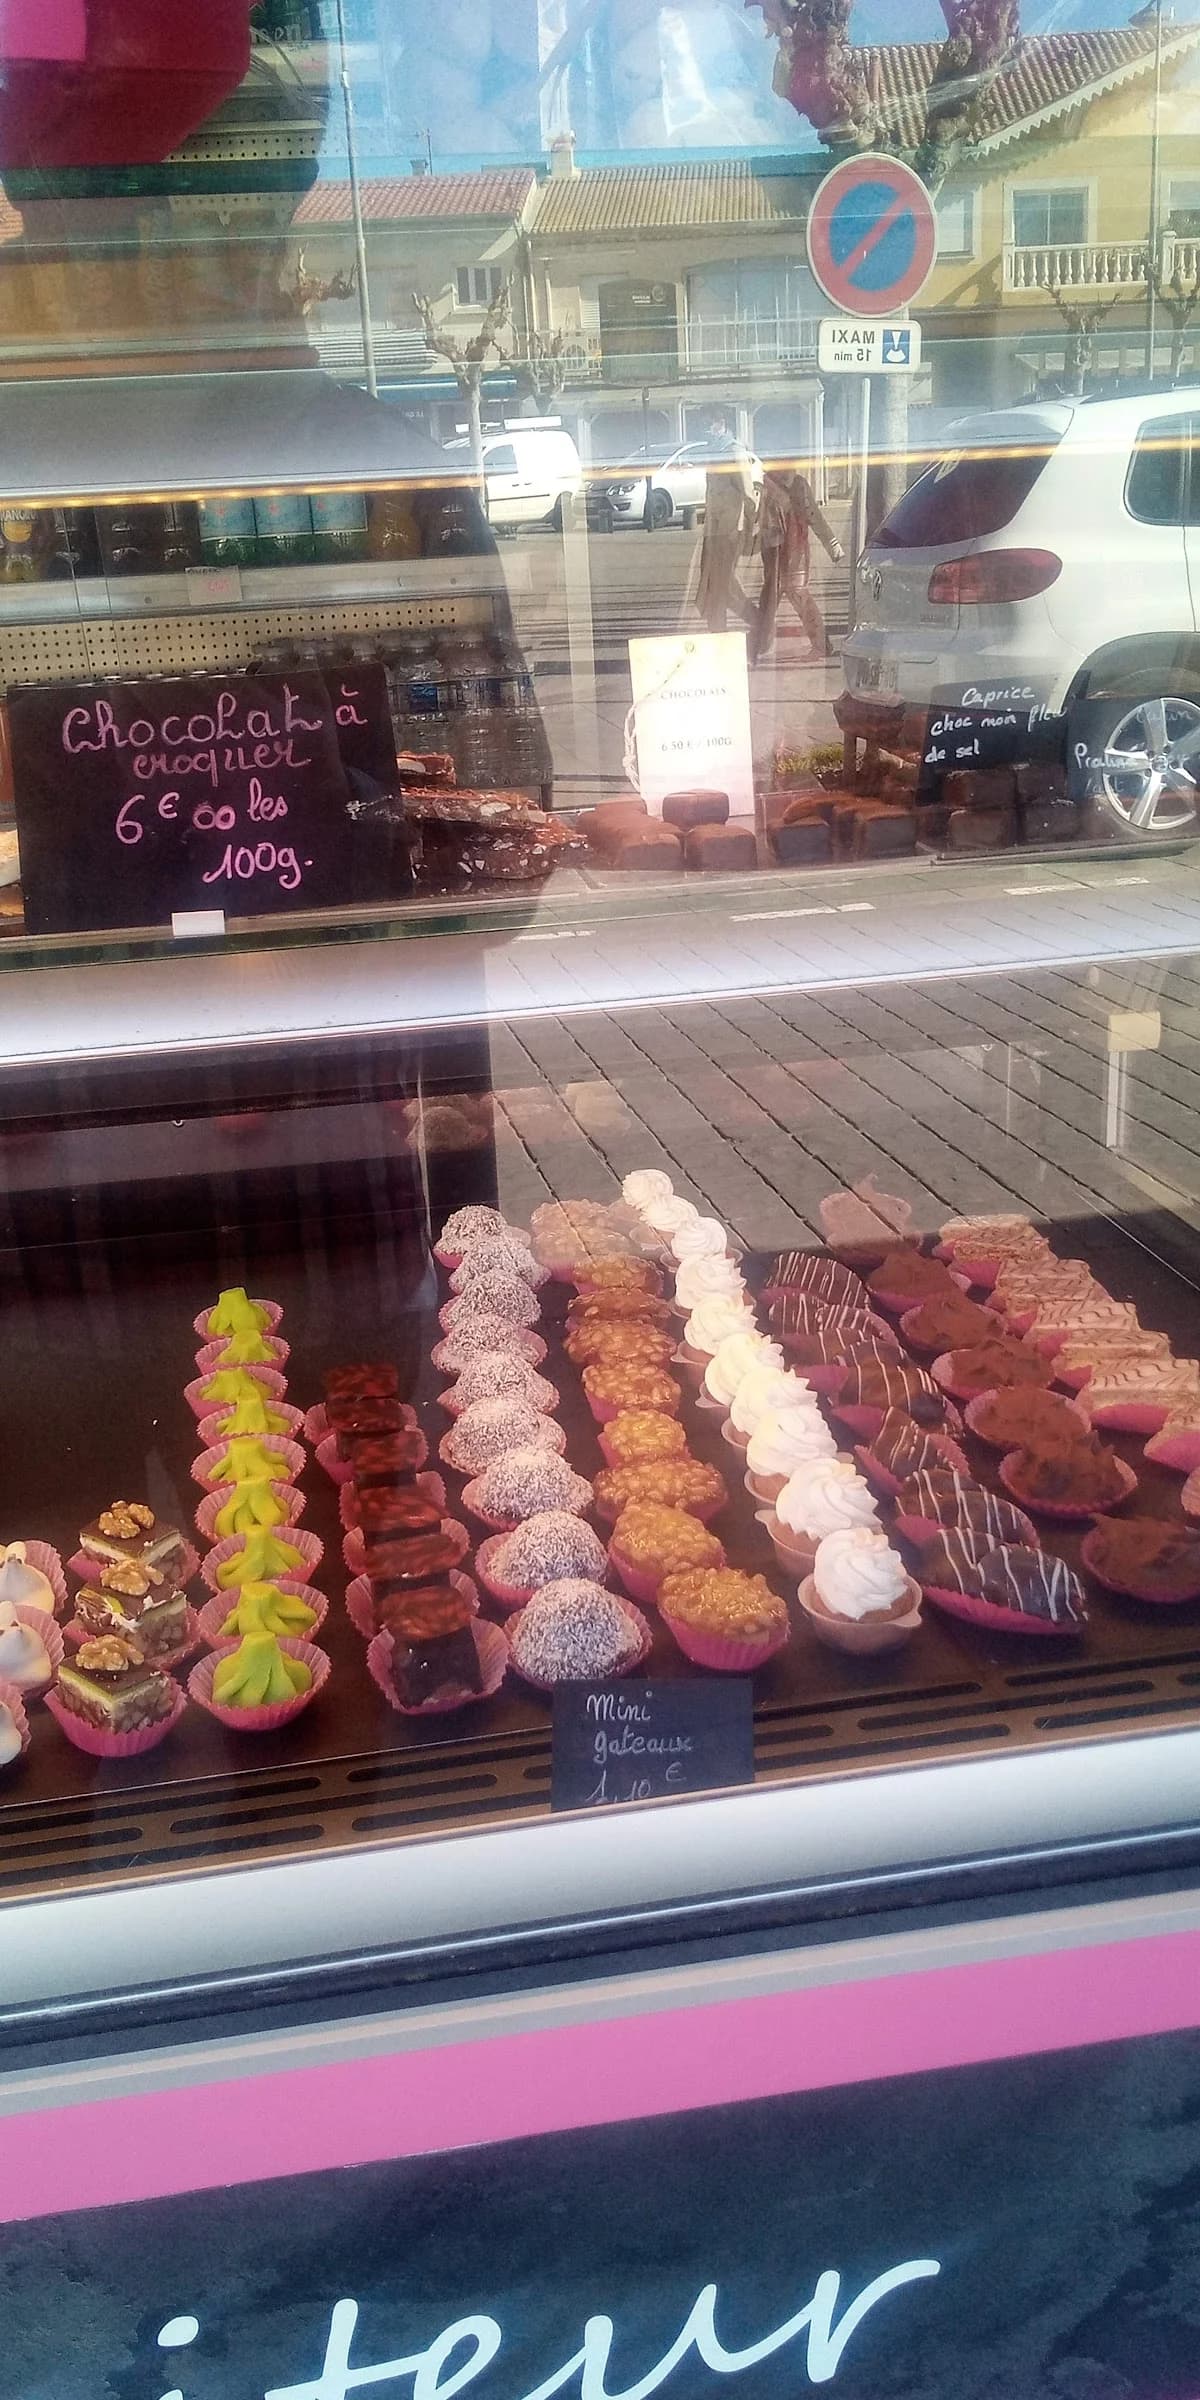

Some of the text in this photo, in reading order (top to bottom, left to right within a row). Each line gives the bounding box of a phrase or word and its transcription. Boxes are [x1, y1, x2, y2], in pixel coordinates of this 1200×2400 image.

[961, 686, 1035, 709] Caprice
[930, 713, 973, 737] choc
[133, 739, 312, 787] croquer
[924, 738, 980, 763] de sel
[247, 777, 288, 822] les
[586, 1691, 652, 1721] Mini
[665, 1762, 686, 1782] €
